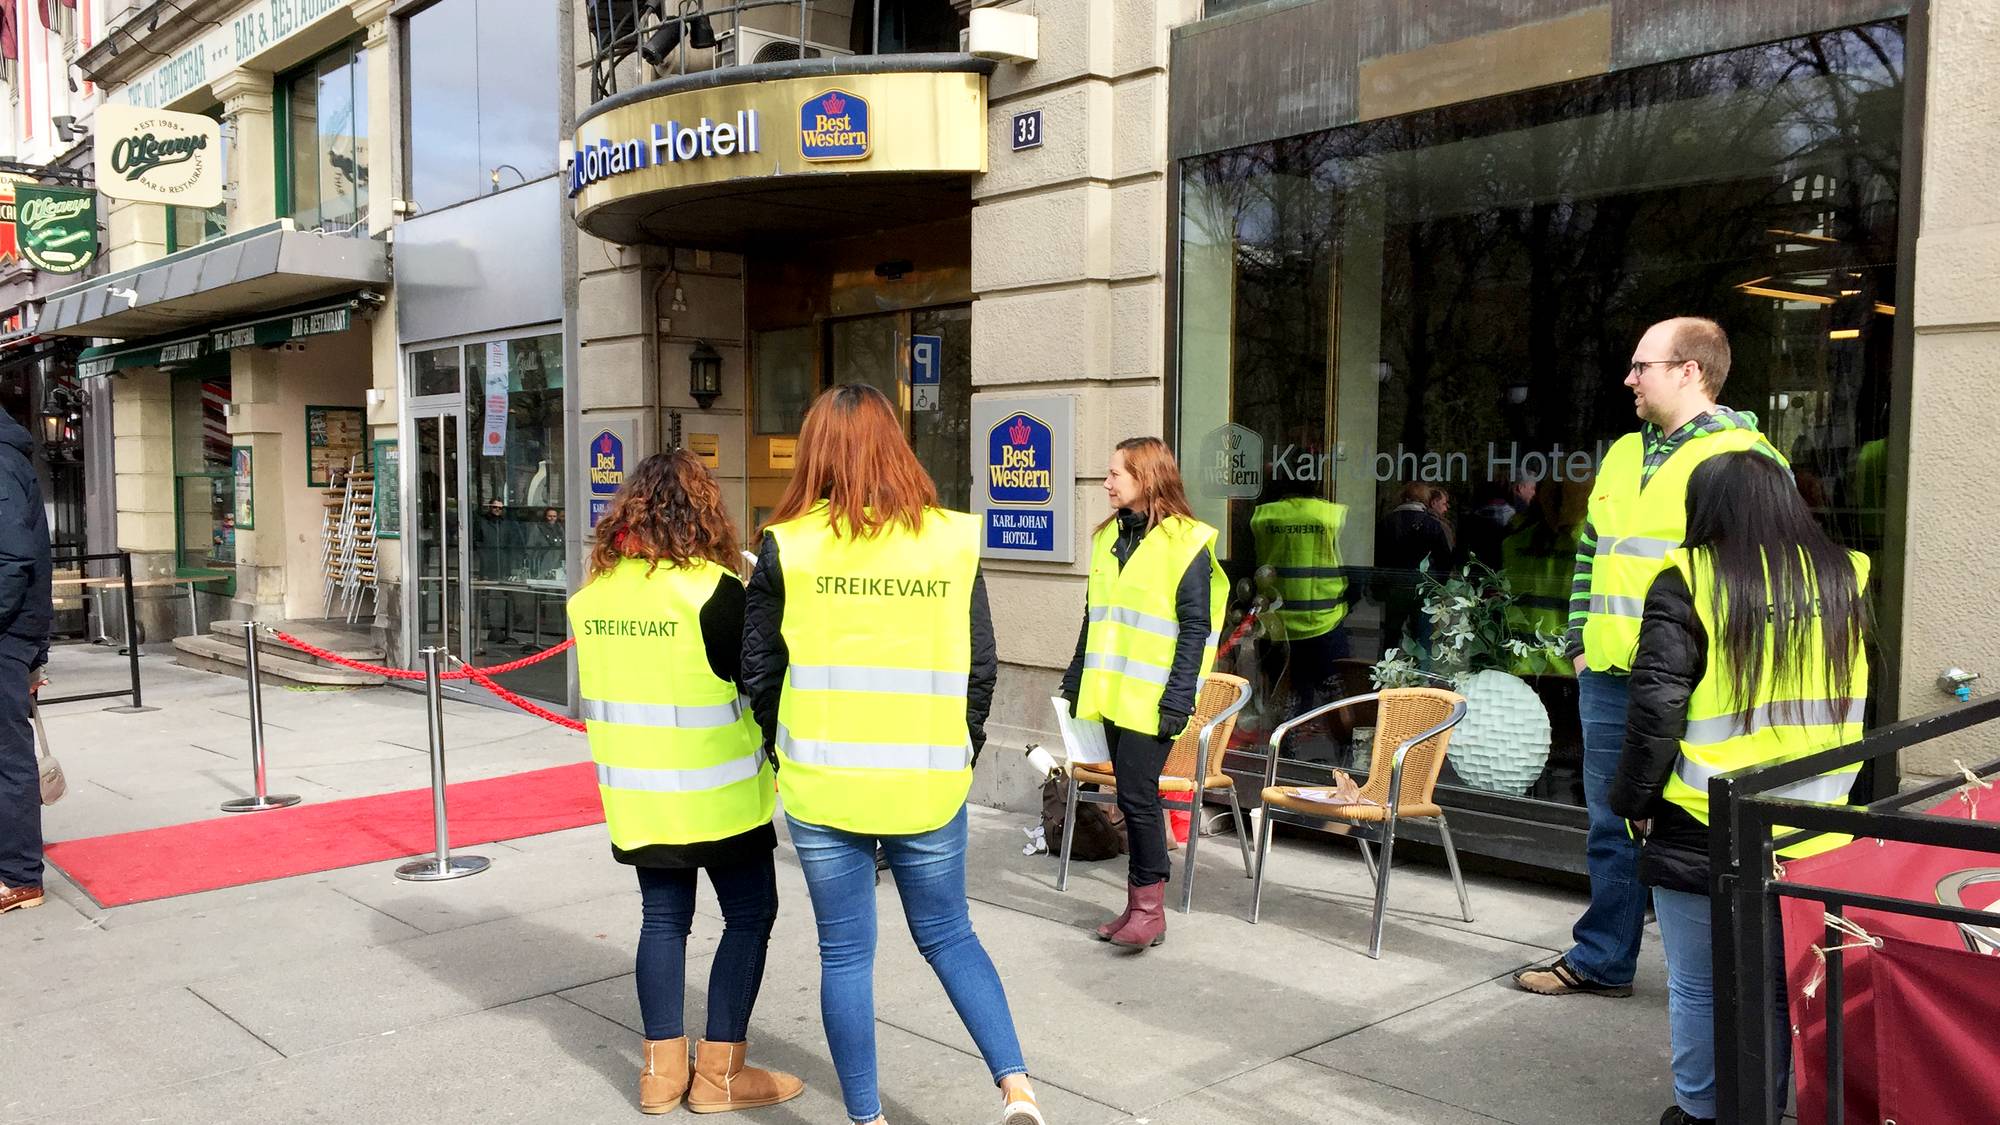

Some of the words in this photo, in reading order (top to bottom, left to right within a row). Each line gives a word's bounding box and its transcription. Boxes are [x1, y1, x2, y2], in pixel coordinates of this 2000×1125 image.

[159, 43, 207, 104] SPORTSBAR
[235, 13, 255, 62] BAR
[258, 12, 269, 47] &
[139, 120, 155, 130] EST
[815, 114, 852, 133] Best
[1018, 117, 1036, 141] 33
[579, 138, 646, 185] Johan
[650, 109, 760, 165] Hotell
[802, 129, 867, 148] Western
[140, 177, 157, 191] BAR
[169, 154, 202, 194] RESTAURANT
[597, 453, 615, 470] Best
[1001, 445, 1036, 468] Best
[1272, 442, 1337, 482] Karl
[1487, 439, 1614, 482] Hotel
[591, 467, 623, 484] Western
[990, 465, 1050, 488] Western
[992, 514, 1017, 529] KARL
[1017, 515, 1048, 529] JOHAN
[1002, 531, 1038, 545] HOTELL
[815, 575, 951, 599] STREIKEVAKT
[584, 618, 679, 638] STREIKEVAKT
